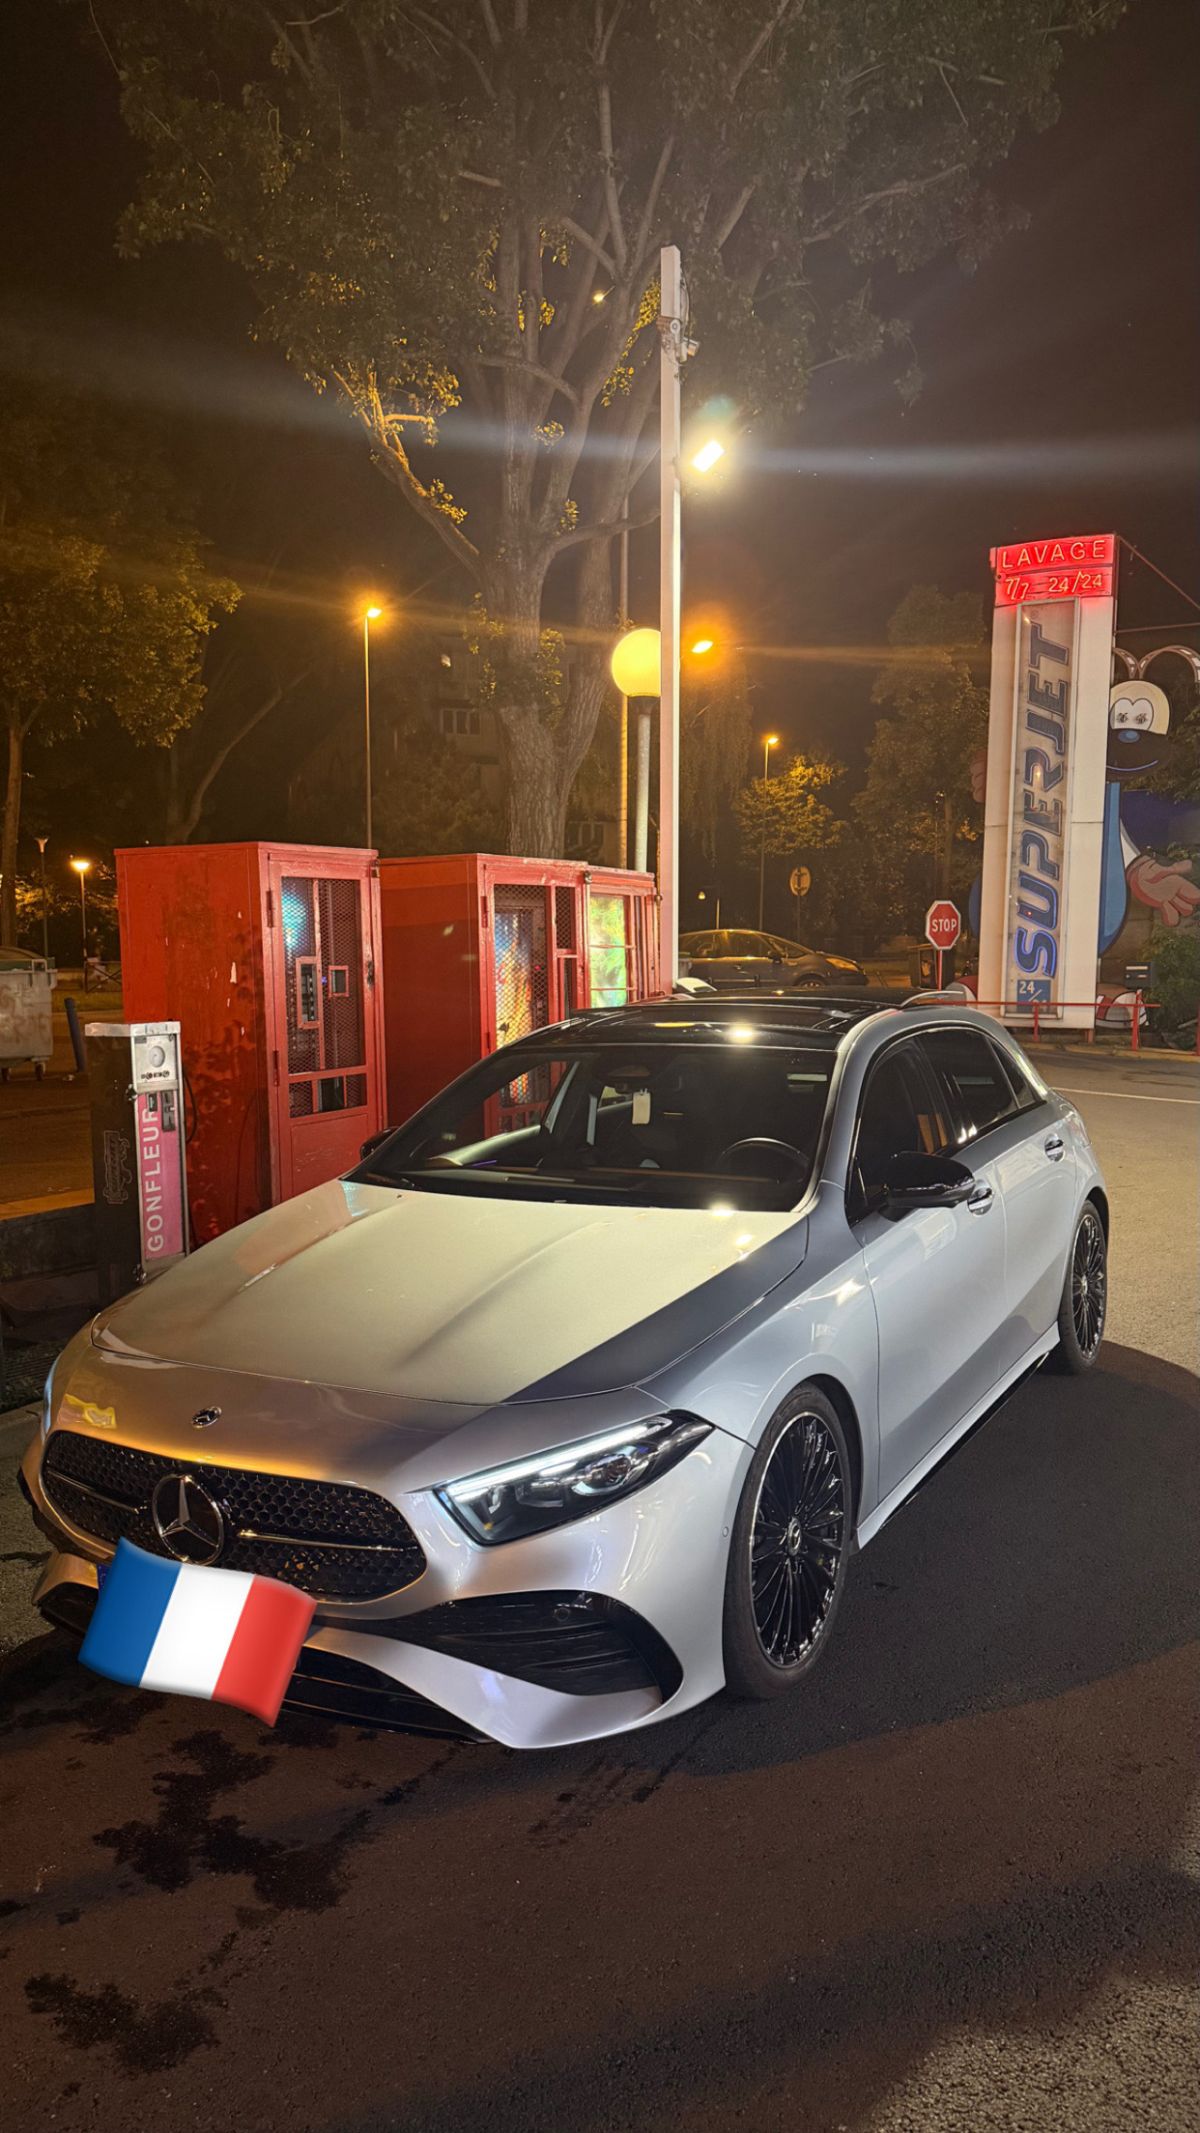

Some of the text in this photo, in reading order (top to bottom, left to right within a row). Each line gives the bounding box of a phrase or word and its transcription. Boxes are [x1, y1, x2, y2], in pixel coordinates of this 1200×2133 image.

[1002, 540, 1105, 568] LAVAGE
[1005, 571, 1103, 600] 7/7 24/24
[1014, 620, 1069, 979] SUPERJET
[931, 918, 957, 932] STOP
[142, 1108, 164, 1252] GONFLEUR
